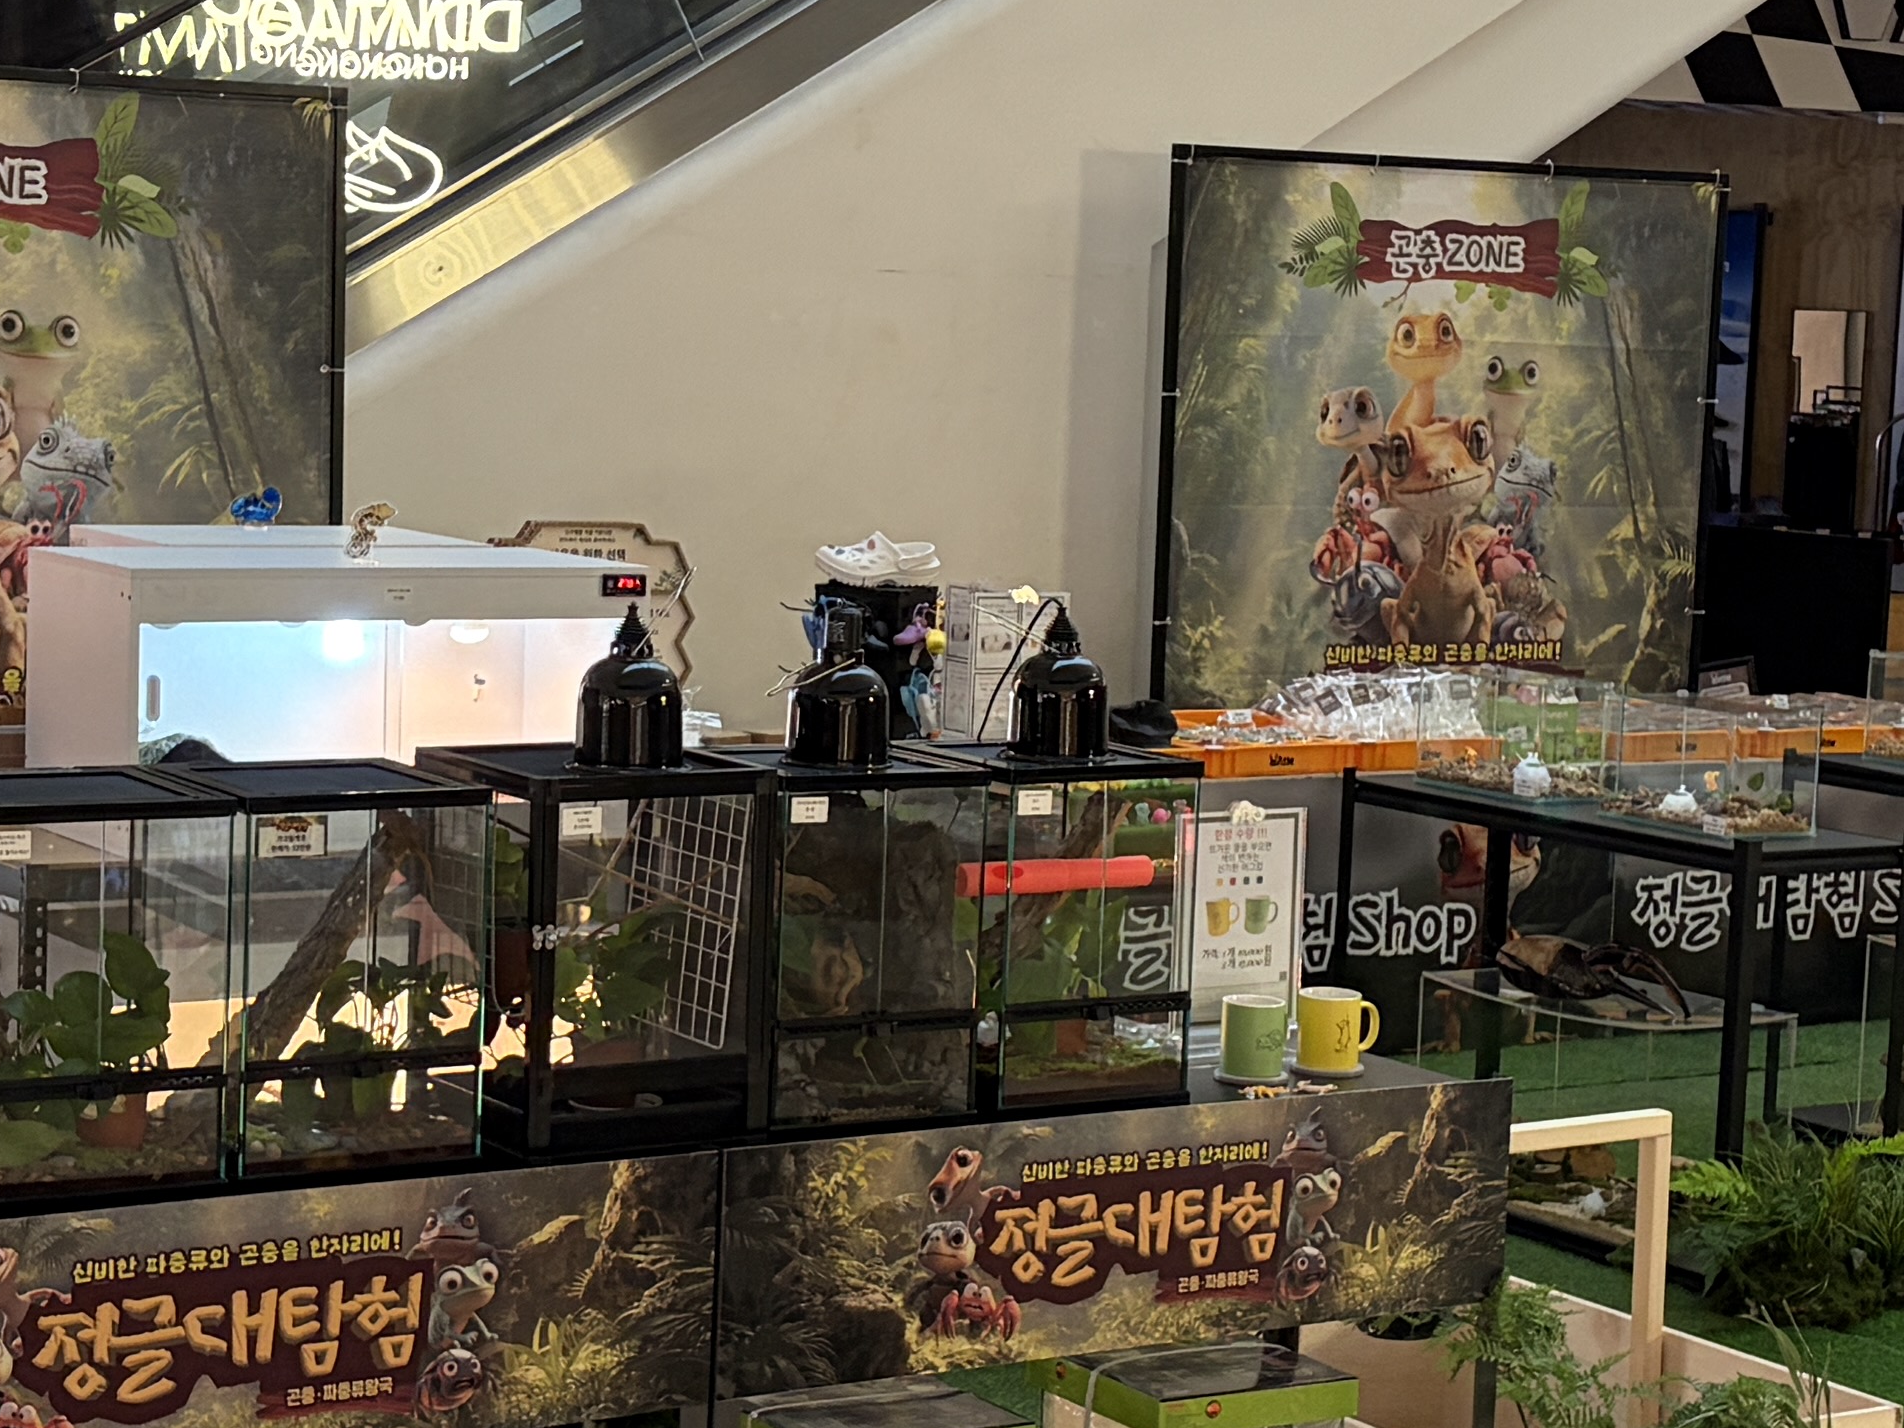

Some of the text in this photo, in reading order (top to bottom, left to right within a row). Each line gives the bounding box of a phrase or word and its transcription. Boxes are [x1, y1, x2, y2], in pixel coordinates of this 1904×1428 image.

[1443, 234, 1525, 273] ZONE
[1346, 887, 1478, 965] Shop
[72, 1228, 402, 1284] 신비한 파충류와 곤충을 한자리에!
[989, 1178, 1284, 1288] 정글대탐험
[34, 1272, 424, 1404] 정글대탐험
